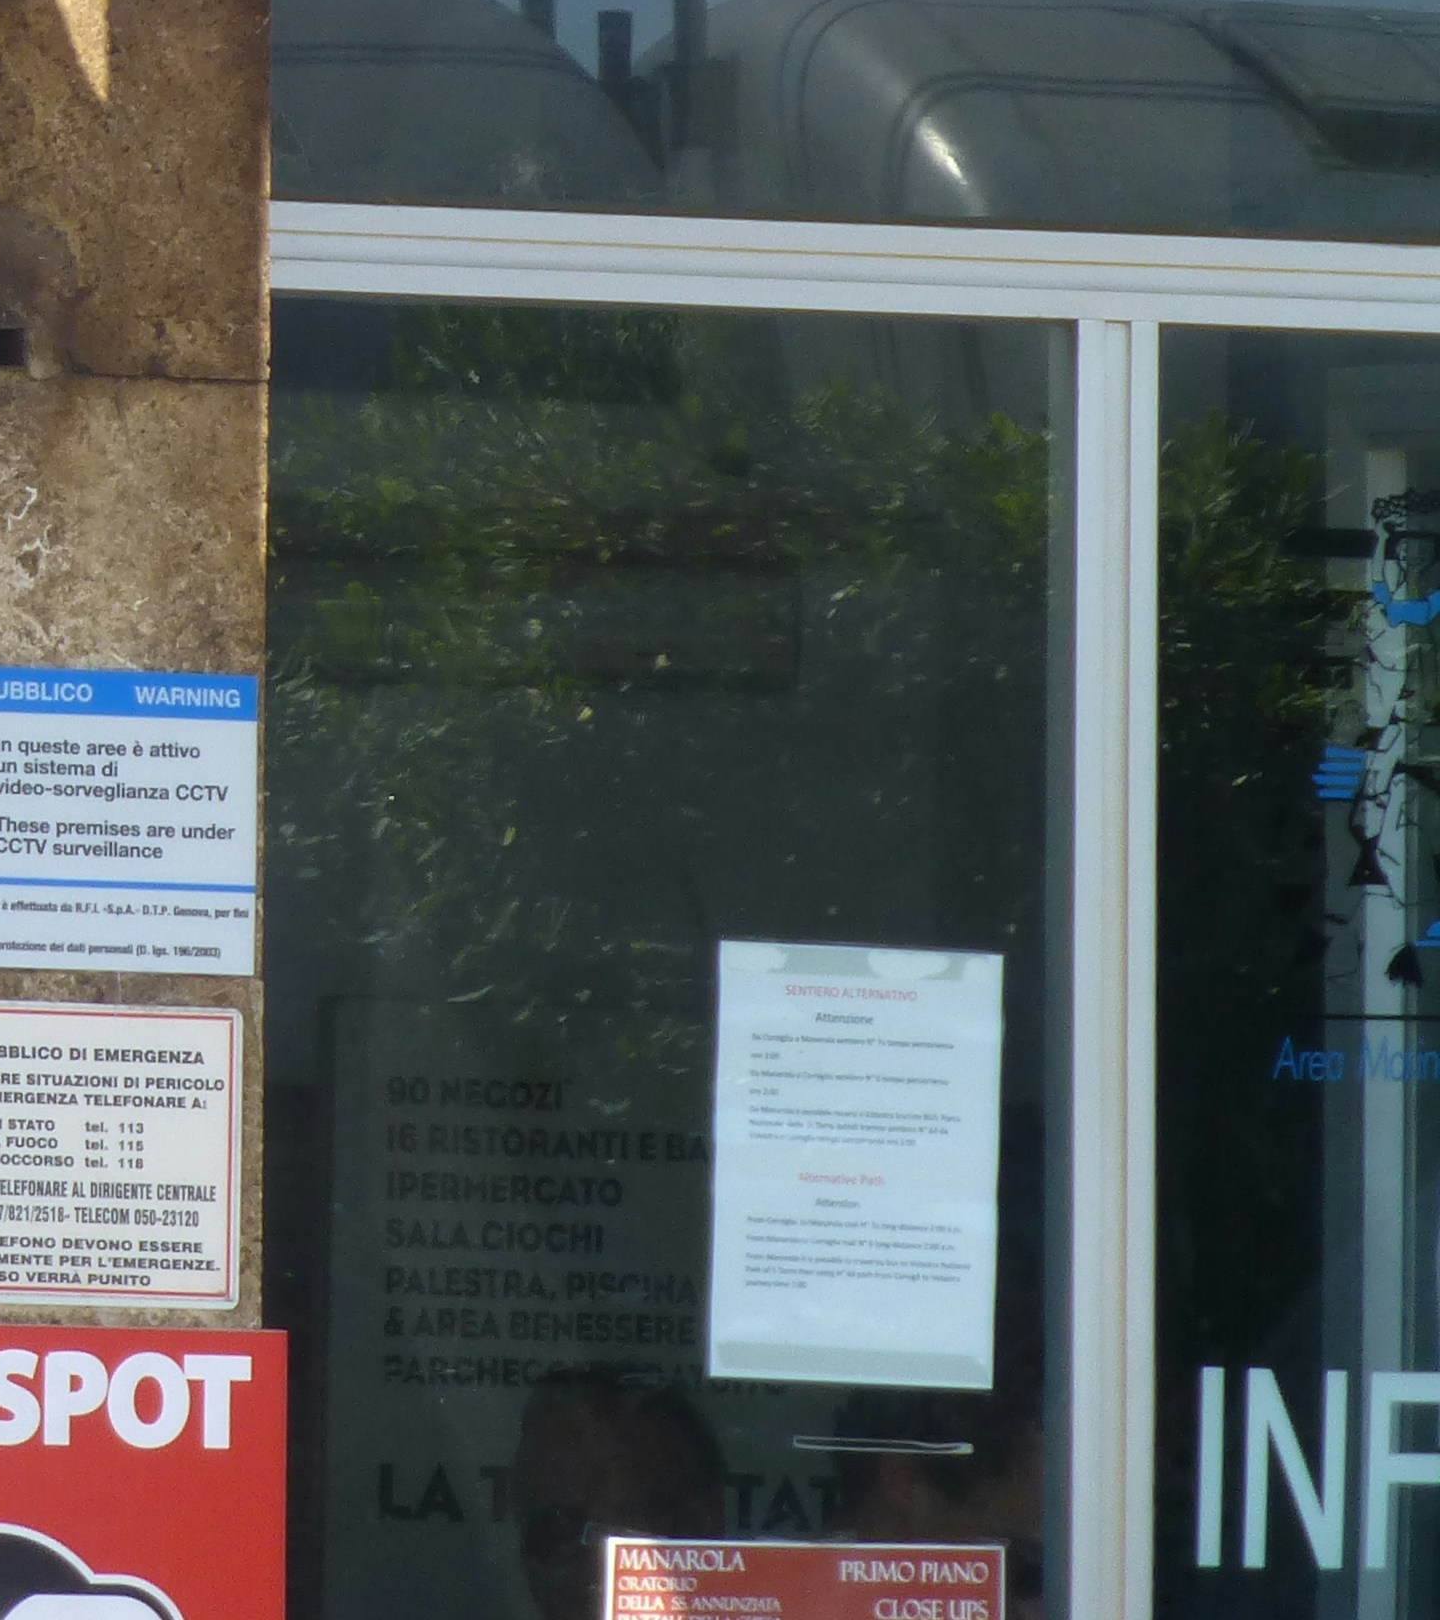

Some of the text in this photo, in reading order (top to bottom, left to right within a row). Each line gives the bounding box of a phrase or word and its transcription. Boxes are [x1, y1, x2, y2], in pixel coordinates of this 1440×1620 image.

[135, 686, 241, 709] WARNING
[18, 739, 80, 756] queste
[86, 742, 126, 756] aree
[133, 740, 144, 756] è
[149, 742, 201, 759] attivo
[23, 758, 95, 776] sistema
[101, 761, 118, 777] di
[175, 784, 229, 802] CCTV
[56, 819, 140, 837] premises
[146, 824, 175, 838] are
[182, 824, 235, 840] under
[52, 841, 163, 859] surveillance
[785, 984, 918, 1002] SENTIERO ALTERNATIVO
[70, 1048, 87, 1061] DI
[93, 1048, 205, 1065] EMERGENZA
[1272, 1035, 1345, 1082] Area
[26, 1073, 118, 1088] SITUAZIONI
[123, 1076, 140, 1089] DI
[145, 1077, 225, 1091] PERICOLO
[84, 1094, 186, 1109] TELEFONARE
[386, 1076, 429, 1108] 90
[8, 1119, 56, 1131] STATO
[85, 1122, 108, 1133] tel.
[119, 1123, 144, 1134] 113
[6, 1136, 58, 1149] FUOCO
[85, 1139, 108, 1151] tel.
[119, 1140, 144, 1152] 115
[428, 1125, 629, 1161] RISTORANTI
[639, 1131, 657, 1162] E
[85, 1157, 108, 1168] tel.
[118, 1158, 144, 1170] 118
[72, 1182, 85, 1198] AL
[90, 1183, 153, 1200] DIRIGENTE
[156, 1184, 217, 1202] CENTRALE
[387, 1171, 624, 1207] IPERMERCATO
[74, 1207, 130, 1225] TELECOM
[134, 1209, 199, 1227] 050-23120
[386, 1218, 470, 1250] SALA
[62, 1238, 133, 1251] DEVONO
[139, 1241, 203, 1253] ESSERE
[59, 1256, 92, 1267] PER
[26, 1270, 82, 1283] VERRÀ
[88, 1274, 151, 1286] PUNITO
[413, 1309, 501, 1340] AREA
[509, 1312, 697, 1346] BENESSERE
[378, 1463, 464, 1521] LA
[619, 1548, 746, 1572] MANAROLA
[840, 1560, 989, 1584] PRIMO PIANO
[619, 1575, 698, 1592] ORATORIO
[618, 1595, 665, 1611] DELLA
[874, 1598, 989, 1620] CLOSE UPS
